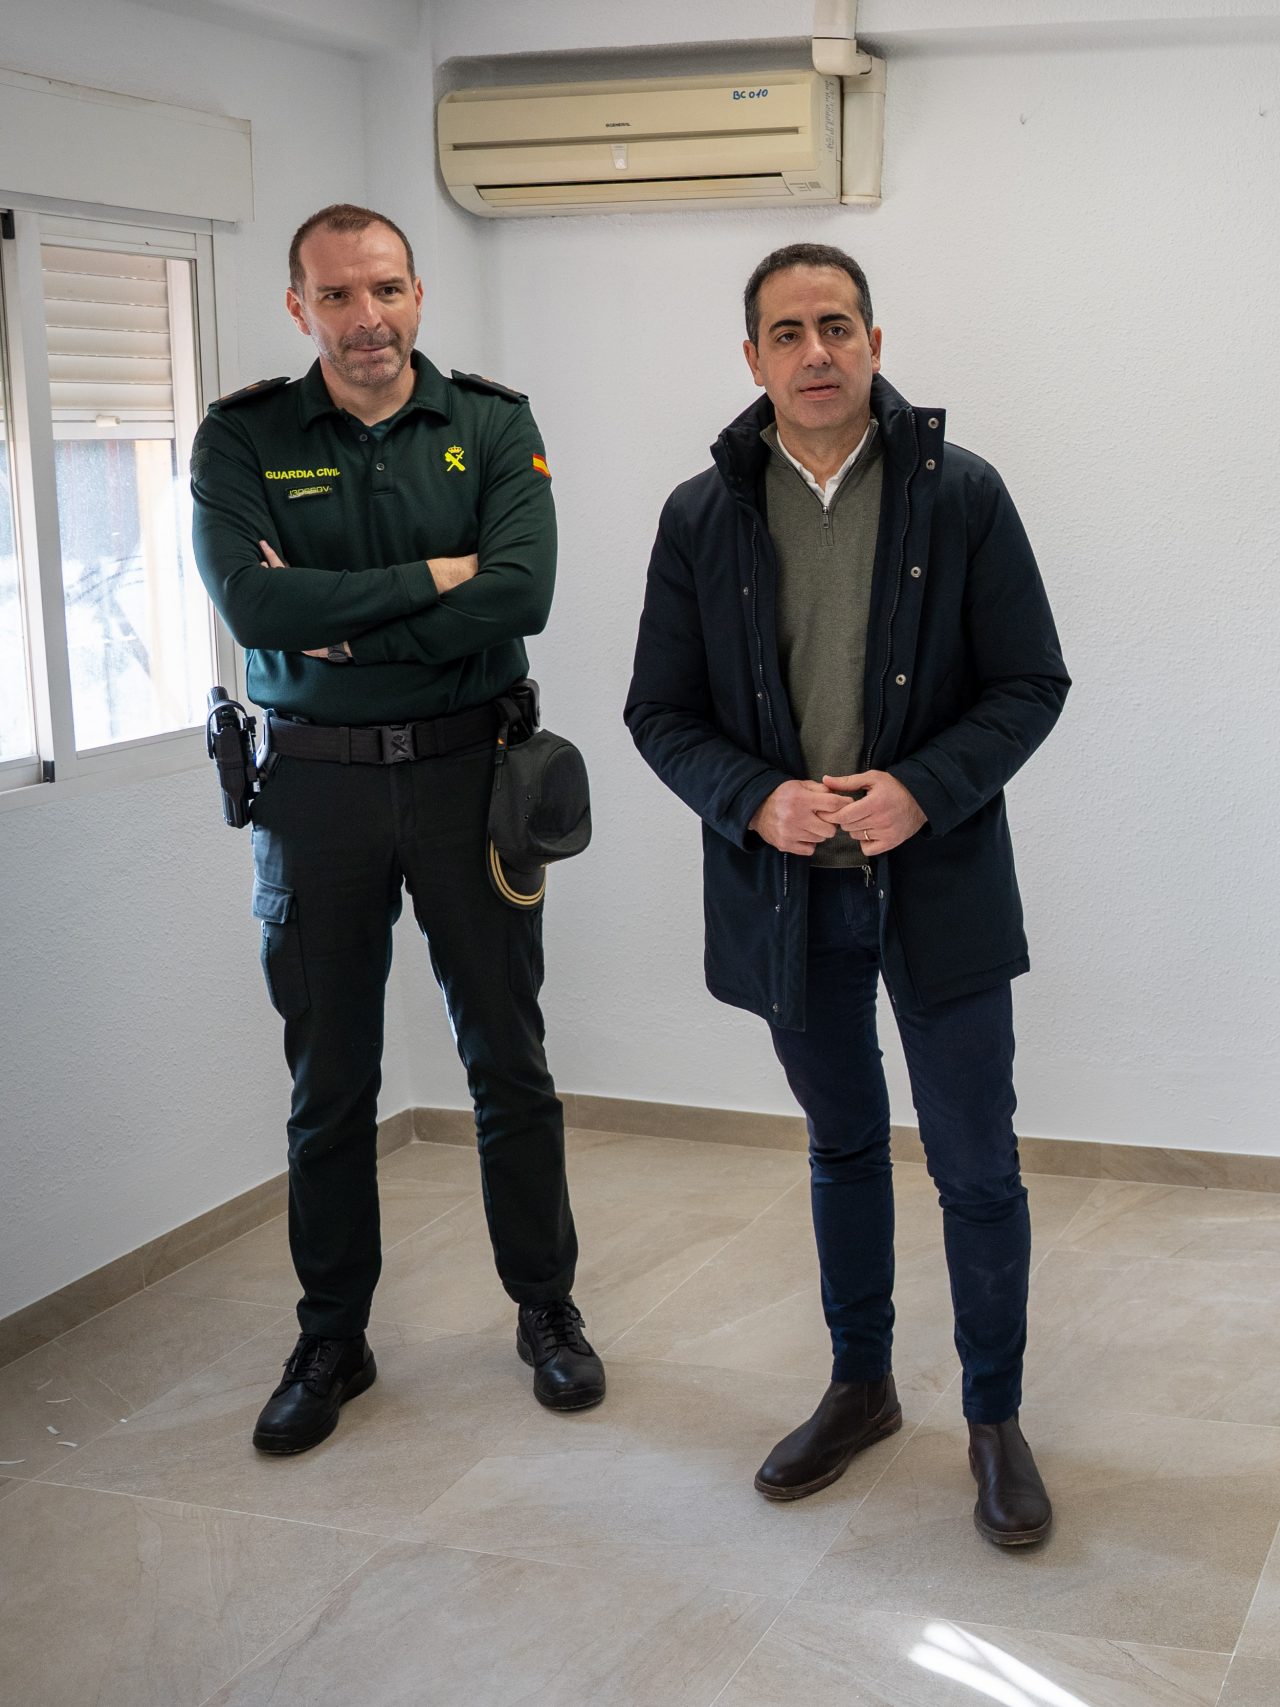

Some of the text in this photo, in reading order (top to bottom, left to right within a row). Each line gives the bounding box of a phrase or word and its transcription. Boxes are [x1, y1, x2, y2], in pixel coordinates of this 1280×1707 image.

[733, 88, 769, 100] BC 010
[265, 467, 341, 480] GUARDIA CIVIL
